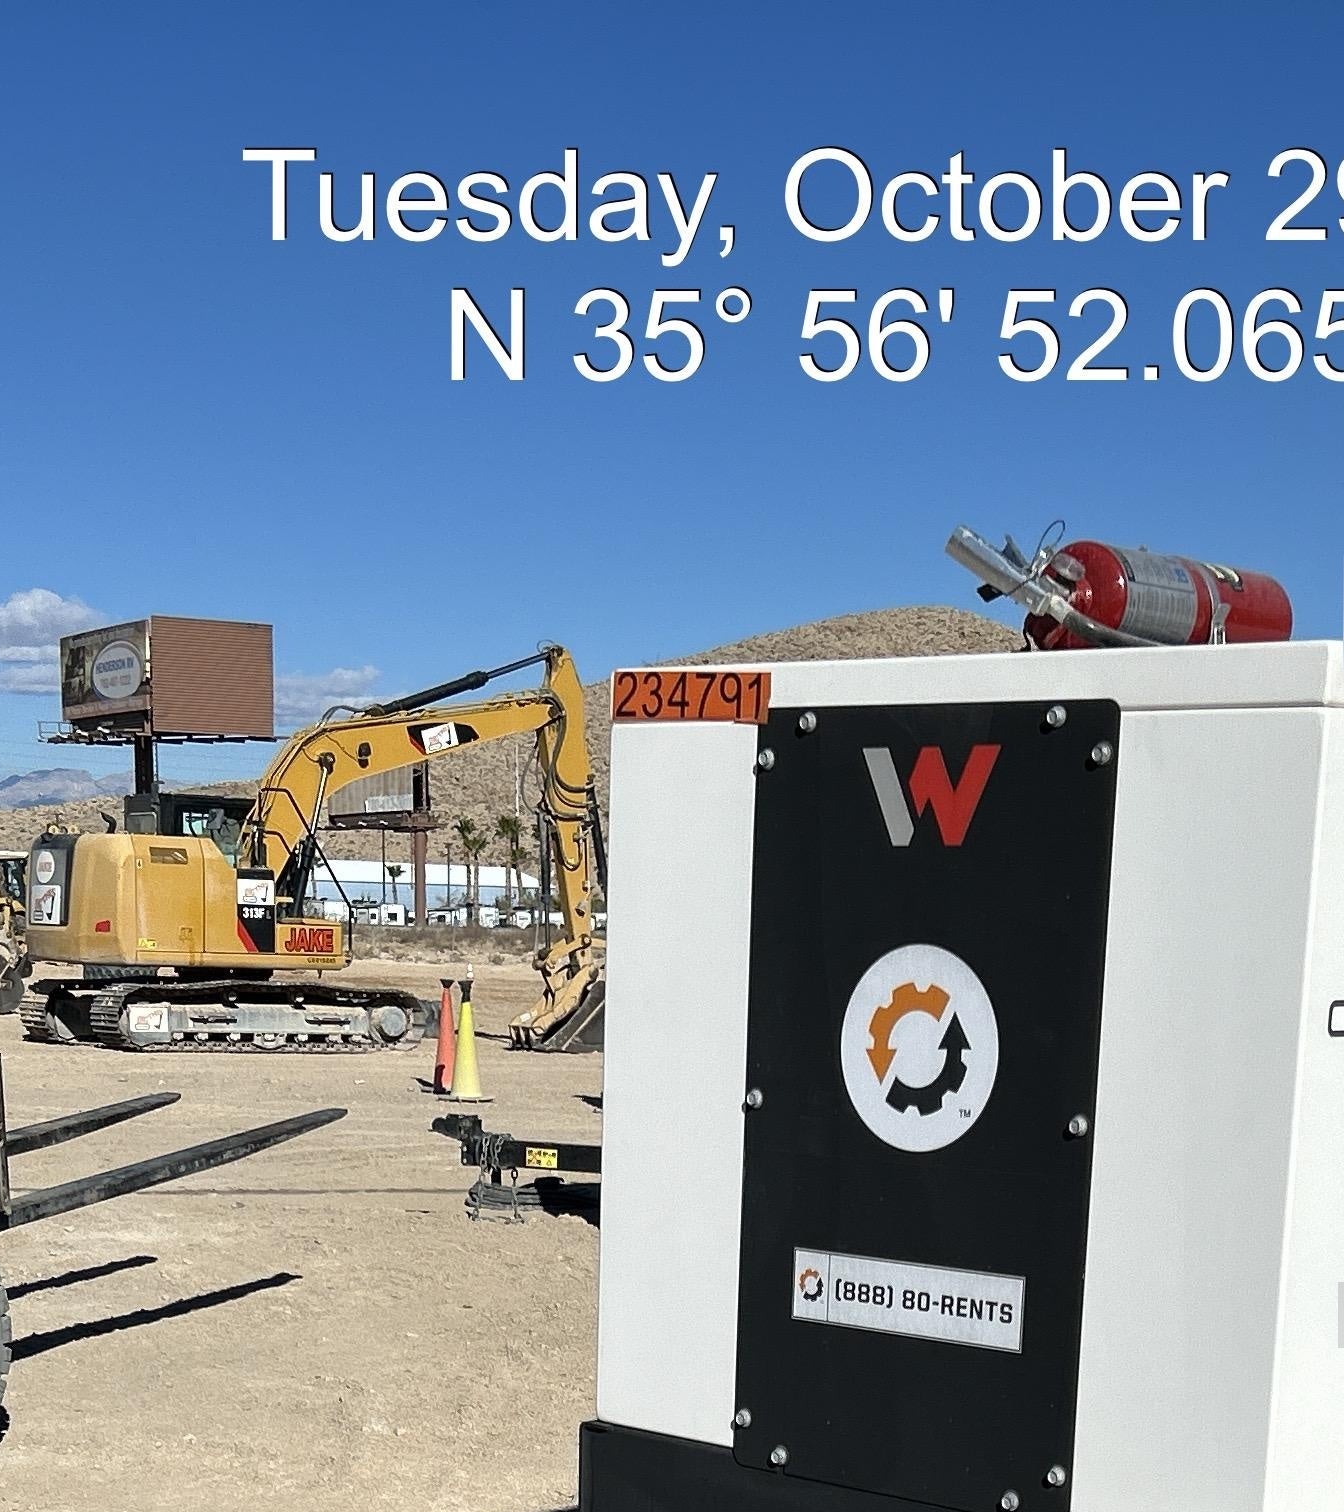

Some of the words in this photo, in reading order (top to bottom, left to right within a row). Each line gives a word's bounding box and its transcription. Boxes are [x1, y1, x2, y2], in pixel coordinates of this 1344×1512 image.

[615, 672, 763, 719] 234791
[242, 907, 265, 919] 313F
[284, 927, 334, 953] JAKE
[834, 1278, 893, 1309] (888)
[902, 1290, 1013, 1324] 80-RENTS
